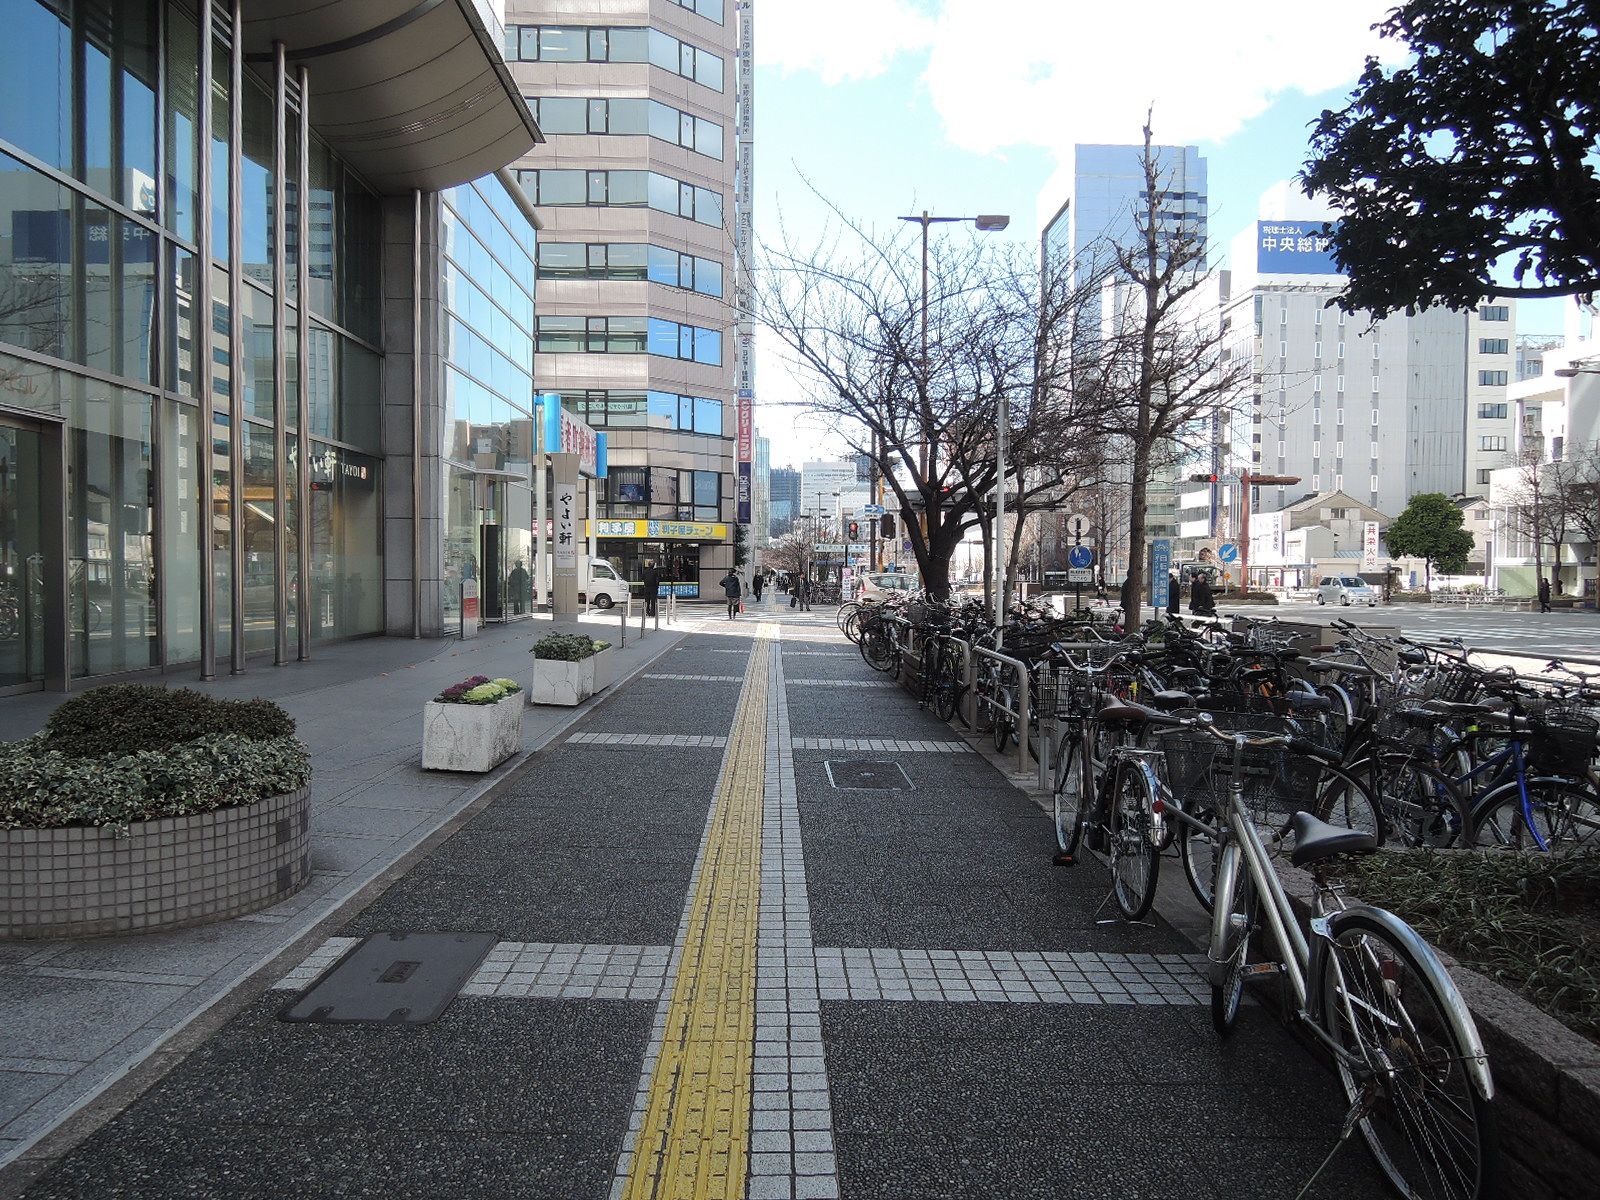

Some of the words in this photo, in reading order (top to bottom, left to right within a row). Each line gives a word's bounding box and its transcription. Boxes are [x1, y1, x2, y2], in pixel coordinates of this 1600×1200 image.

[1262, 236, 1329, 253] 中央総研
[340, 462, 361, 479] YAYOI
[559, 493, 573, 546] やよい軒
[1366, 527, 1377, 567] 共栄火災
